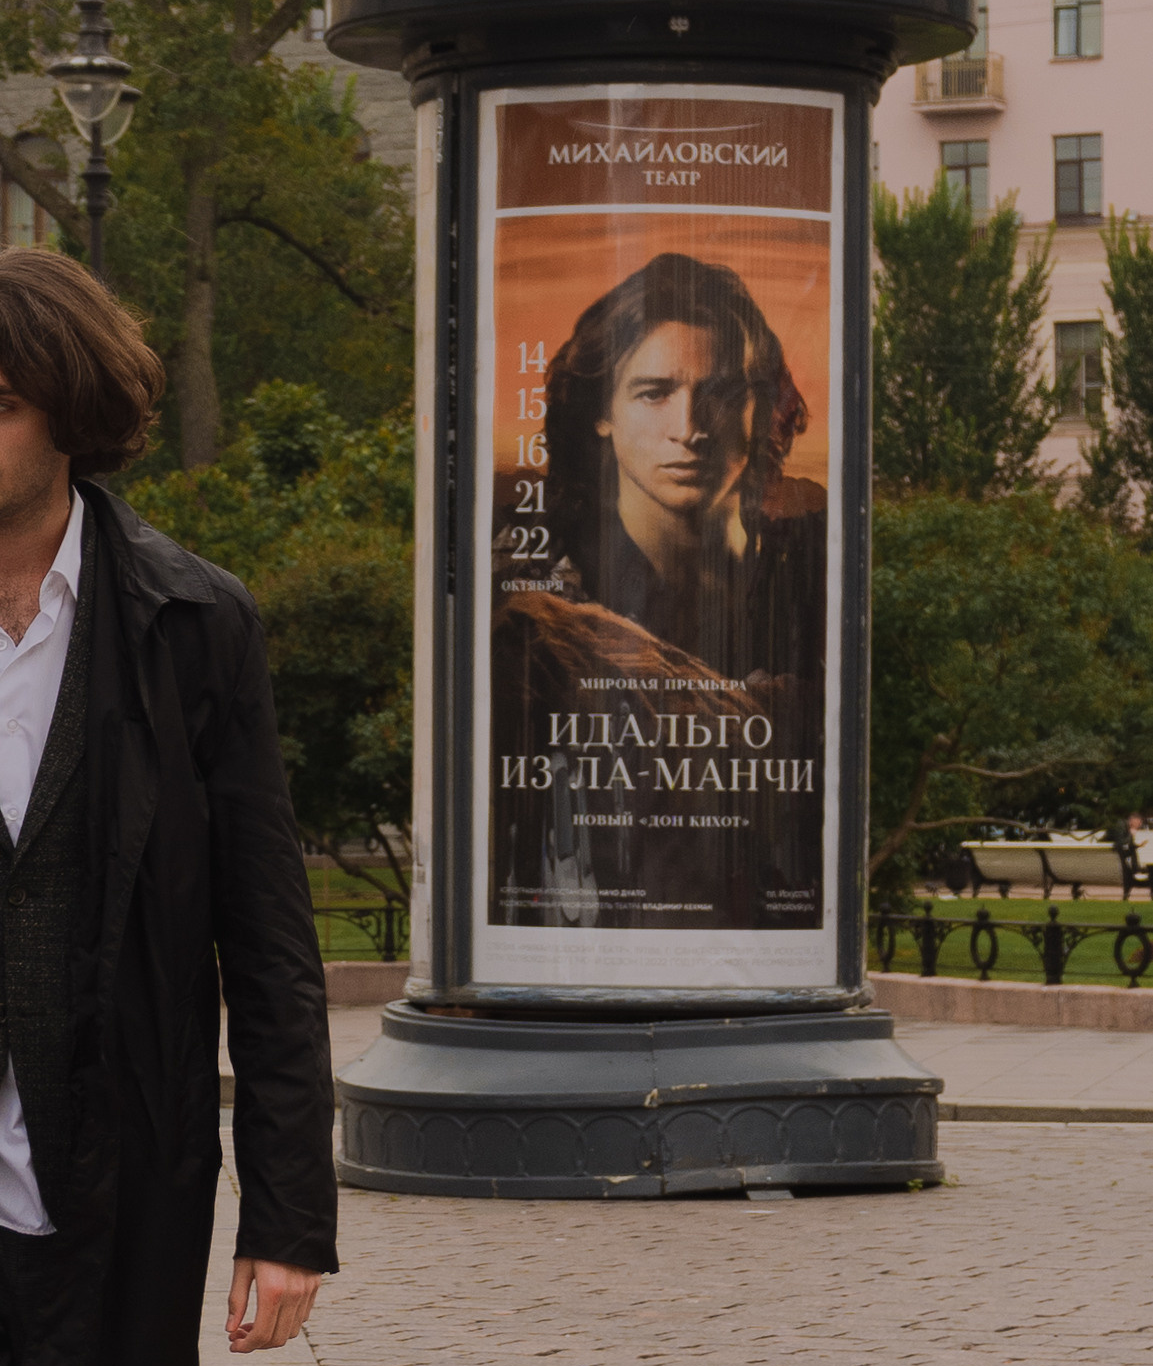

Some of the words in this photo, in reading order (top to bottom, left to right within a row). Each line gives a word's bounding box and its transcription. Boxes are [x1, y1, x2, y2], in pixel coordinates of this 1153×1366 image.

[548, 139, 788, 167] МИХАЙЛОВСКИЙ
[642, 170, 701, 186] ТЕАТР
[517, 341, 548, 374] 14
[517, 386, 548, 420] 15
[515, 433, 548, 467] 16
[515, 480, 546, 513] 21
[510, 526, 549, 559] 22
[501, 580, 564, 592] ОКТЯБРЯ
[579, 677, 658, 691] МИРОВАЯ
[664, 678, 747, 692] ПРЕМЬЕРА
[548, 712, 773, 753] ИДАЛЬГО
[501, 755, 554, 790] ИЗ
[569, 756, 815, 792] ЛА-МАНЧИ
[573, 810, 634, 827] НОВЫЙ
[639, 815, 684, 828] «ДОН
[689, 815, 751, 828] КИХОТ»
